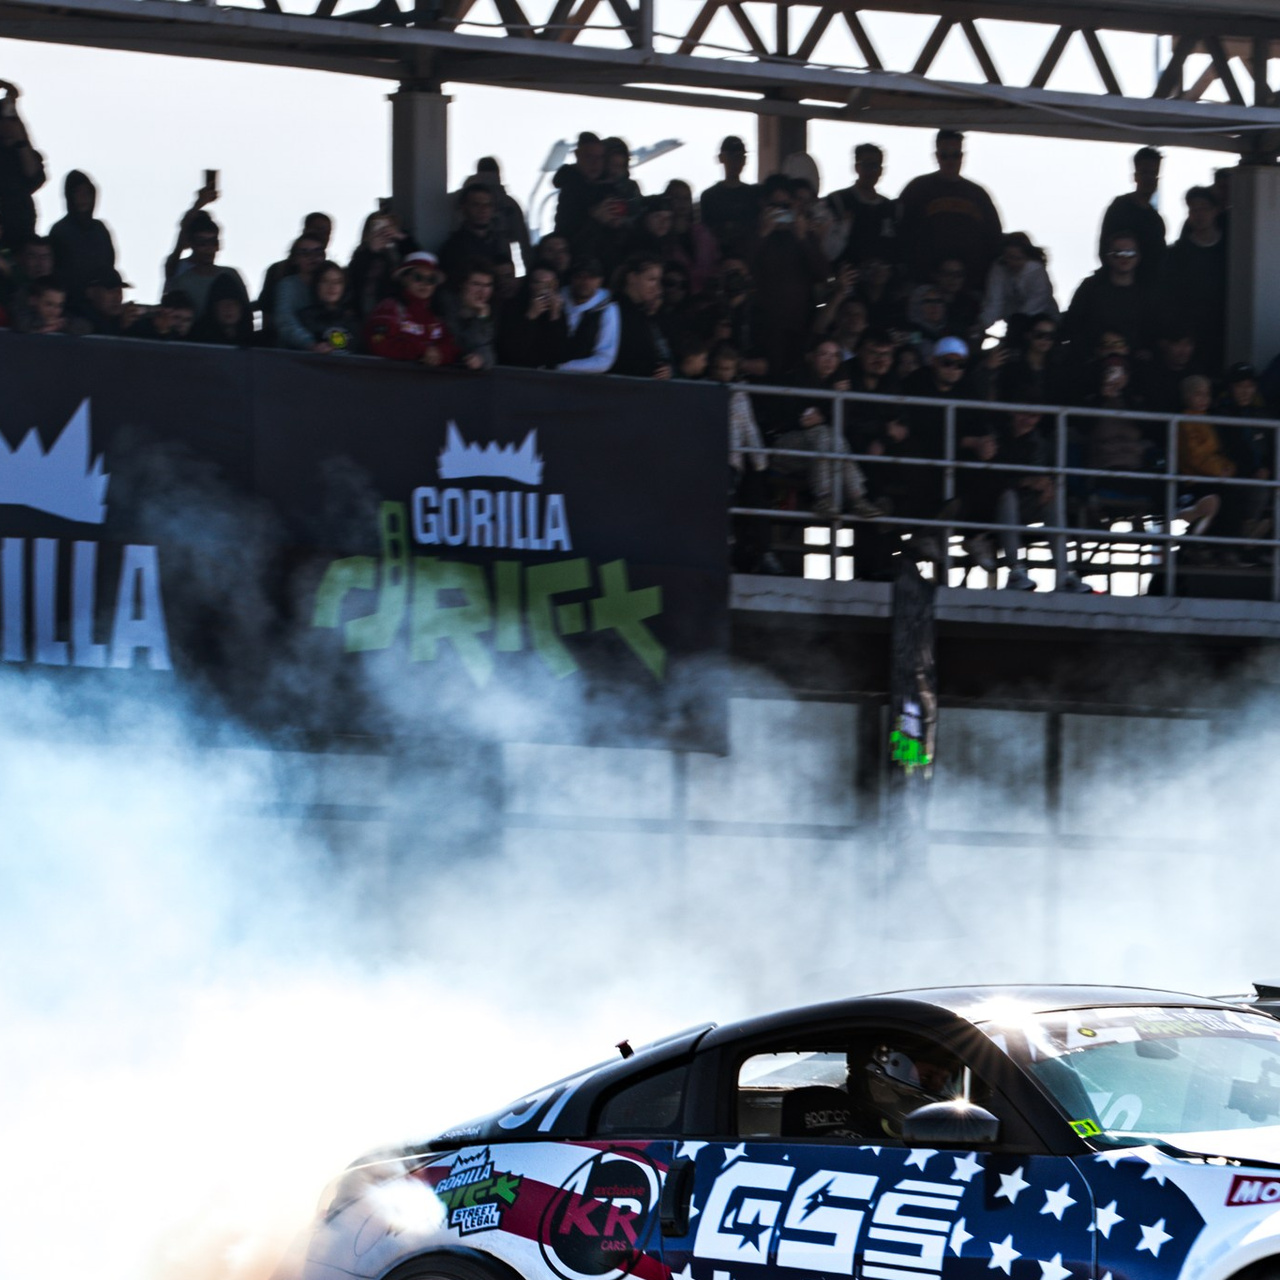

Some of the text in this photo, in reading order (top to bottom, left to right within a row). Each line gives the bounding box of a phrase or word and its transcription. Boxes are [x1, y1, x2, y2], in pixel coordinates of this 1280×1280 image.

[412, 486, 572, 551] GORILLA
[434, 1163, 493, 1195] GORILLA
[454, 1205, 496, 1222] STREET
[464, 1213, 496, 1230] LEGAL
[601, 1240, 627, 1251] CARS
